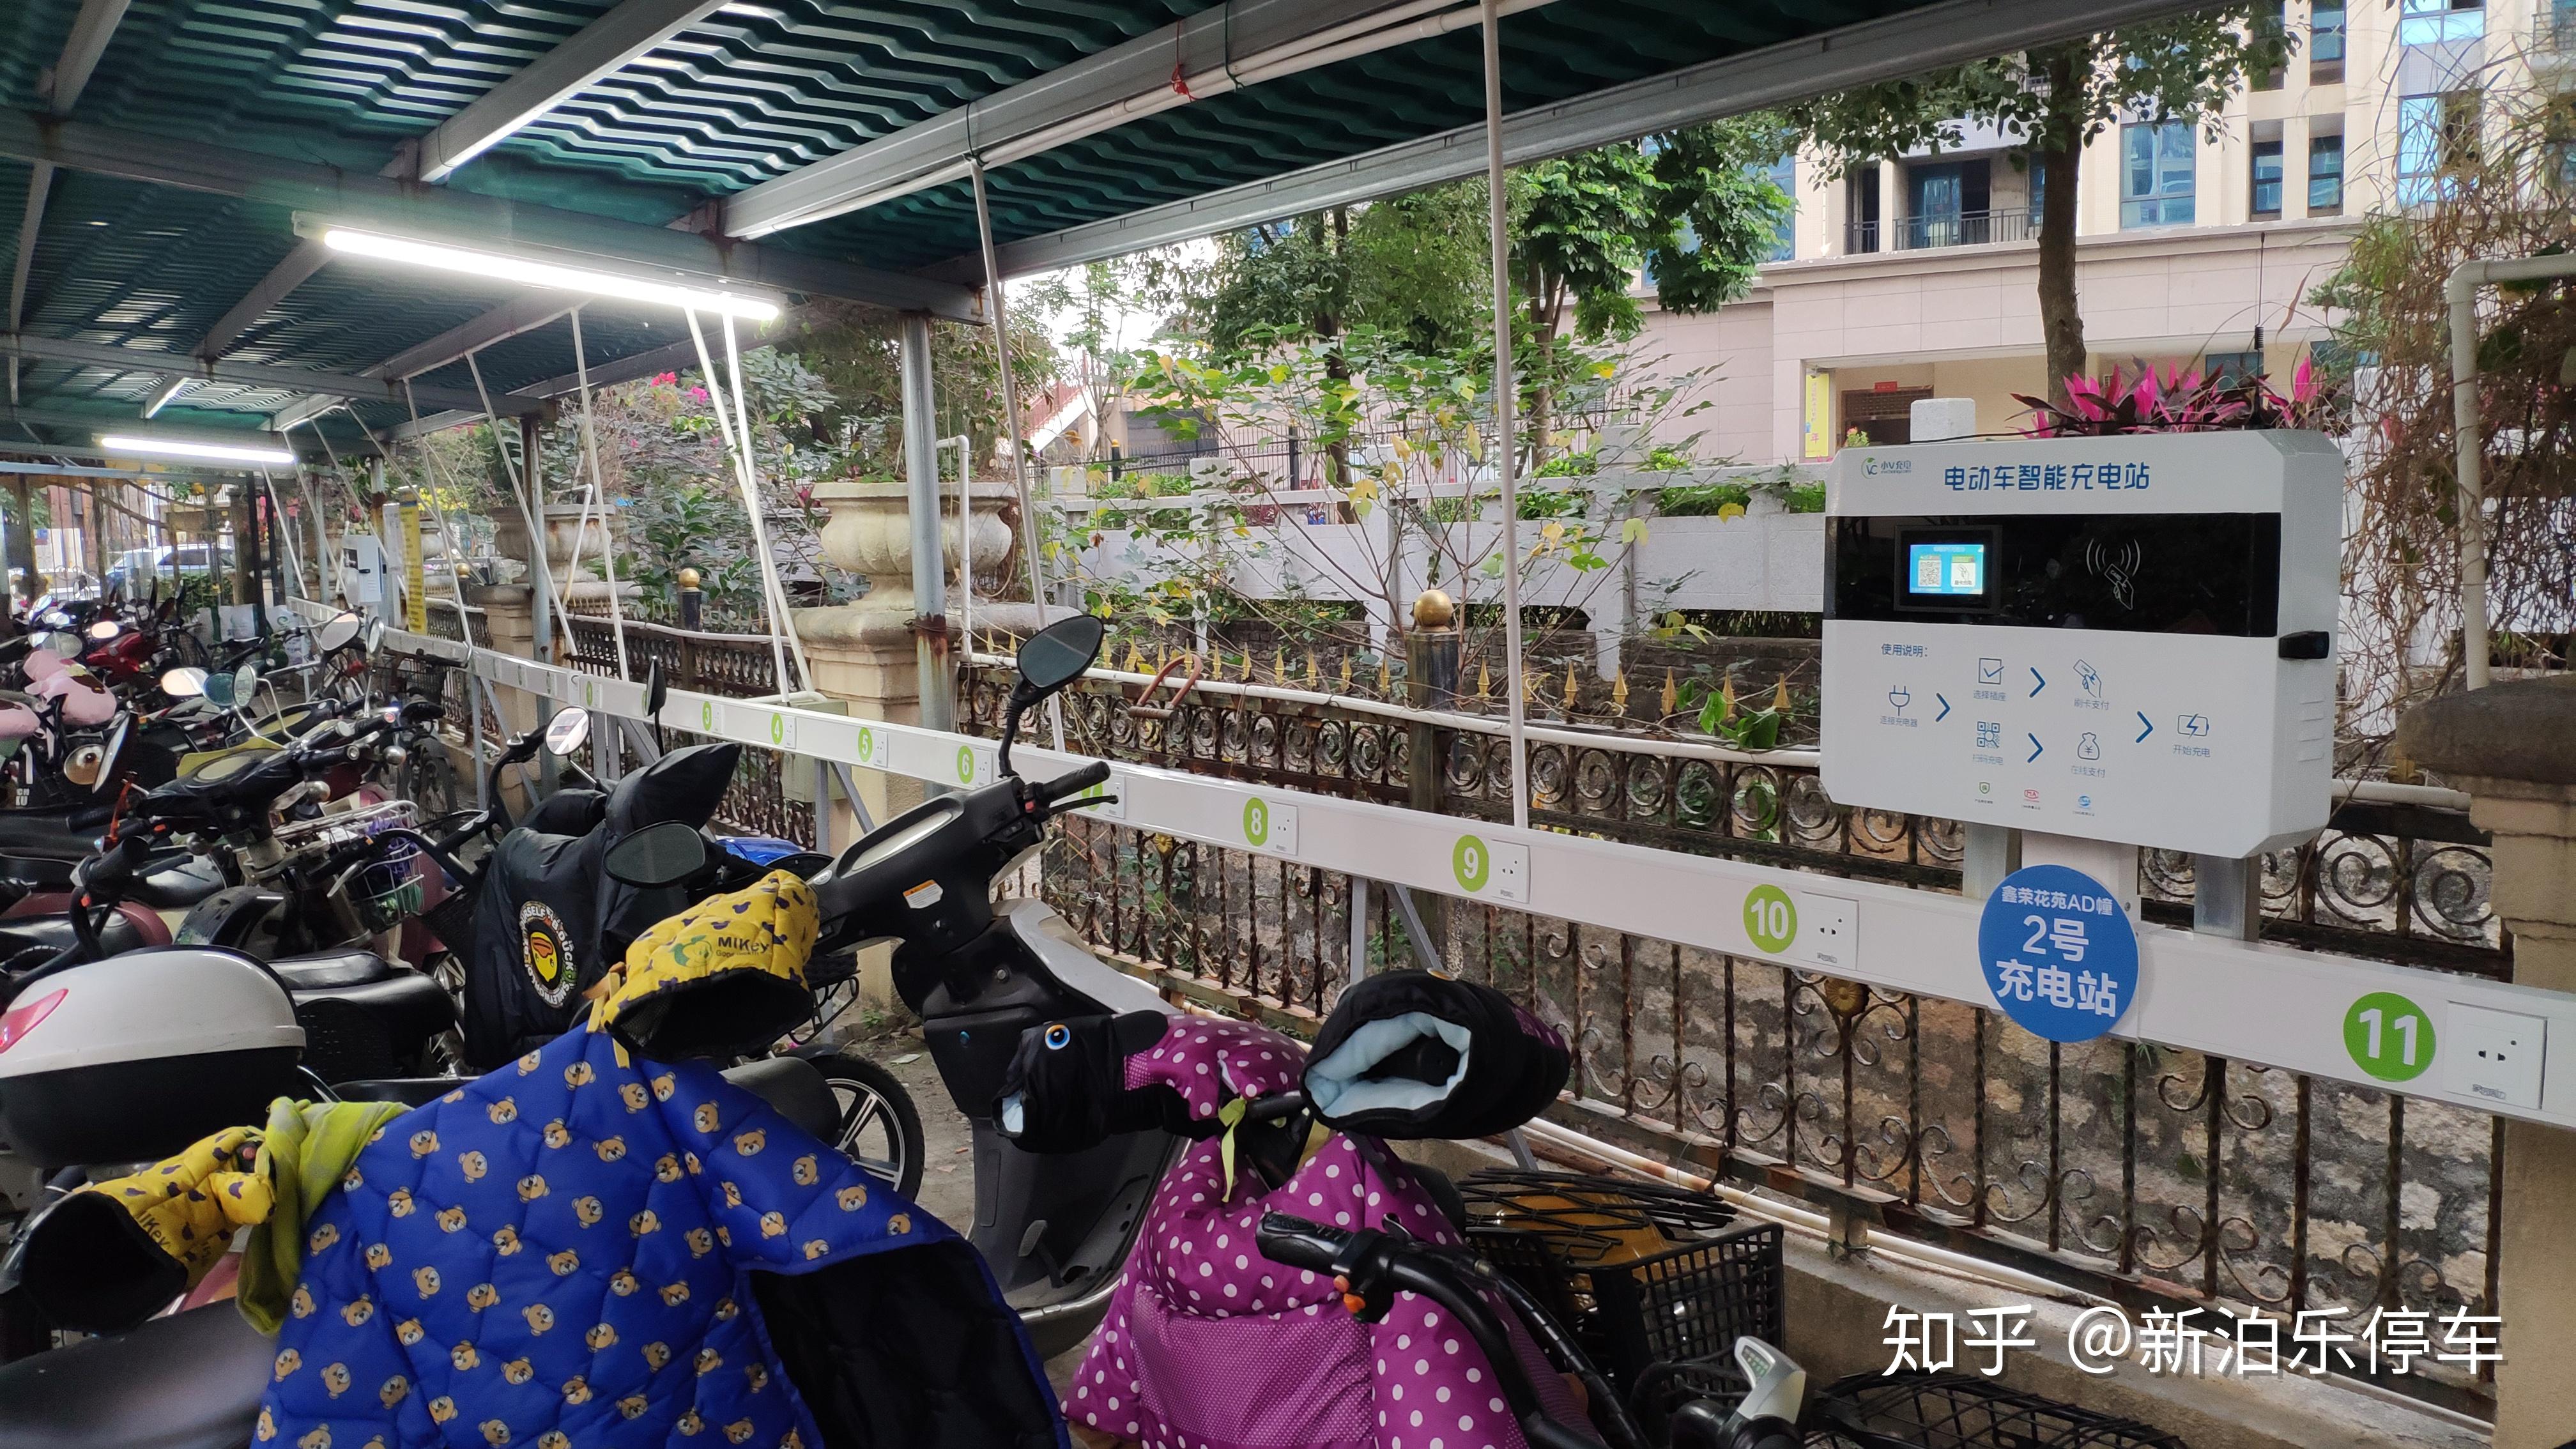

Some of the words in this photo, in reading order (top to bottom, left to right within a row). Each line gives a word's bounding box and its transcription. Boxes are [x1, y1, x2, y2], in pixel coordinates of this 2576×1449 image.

[1944, 461, 2150, 491] 电动车智能充电站
[1973, 690, 2006, 702] 选择插座
[2074, 698, 2110, 710] 刷卡支付
[705, 707, 710, 724] 3
[1880, 716, 1918, 727] 连接充电器
[774, 719, 780, 738] 4
[862, 734, 868, 755] 5
[2173, 744, 2211, 758] 开始充电
[962, 754, 970, 776] 6
[2071, 765, 2106, 778] 在线支付
[1250, 808, 1262, 836] 8
[1463, 847, 1479, 879] 9
[2001, 885, 2113, 916] 鑫荣花苑AD幢
[1751, 898, 1790, 940] 10
[2022, 914, 2090, 962] 2号
[1996, 958, 2118, 1018] 充电站
[2359, 1008, 2418, 1066] 11
